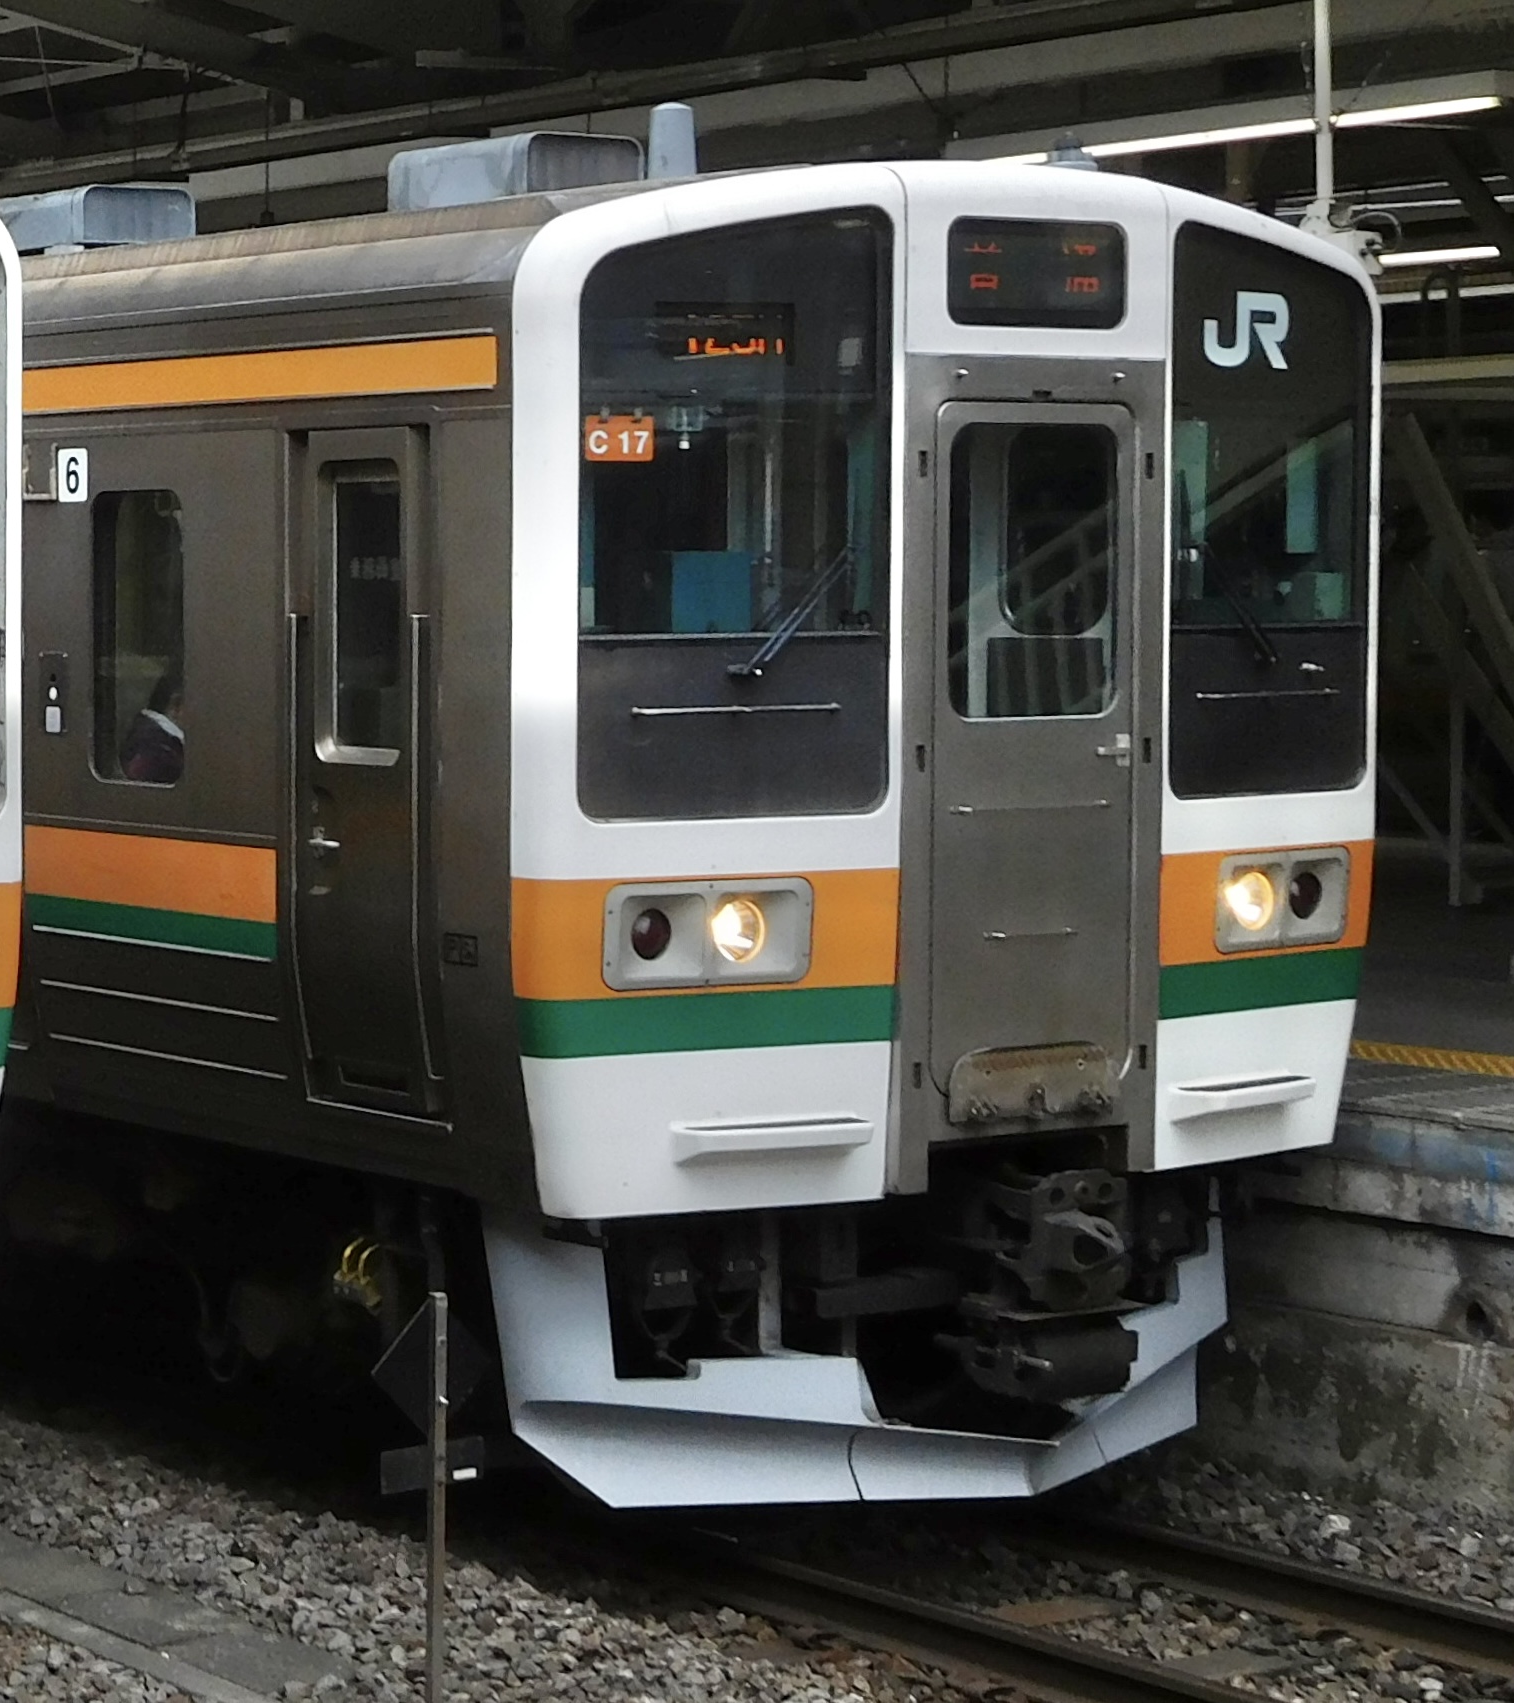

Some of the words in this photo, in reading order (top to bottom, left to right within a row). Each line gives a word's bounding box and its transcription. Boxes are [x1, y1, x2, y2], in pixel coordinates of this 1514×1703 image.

[1203, 290, 1289, 370] JR
[588, 429, 609, 455] C
[618, 430, 650, 454] 17
[66, 456, 80, 495] 6
